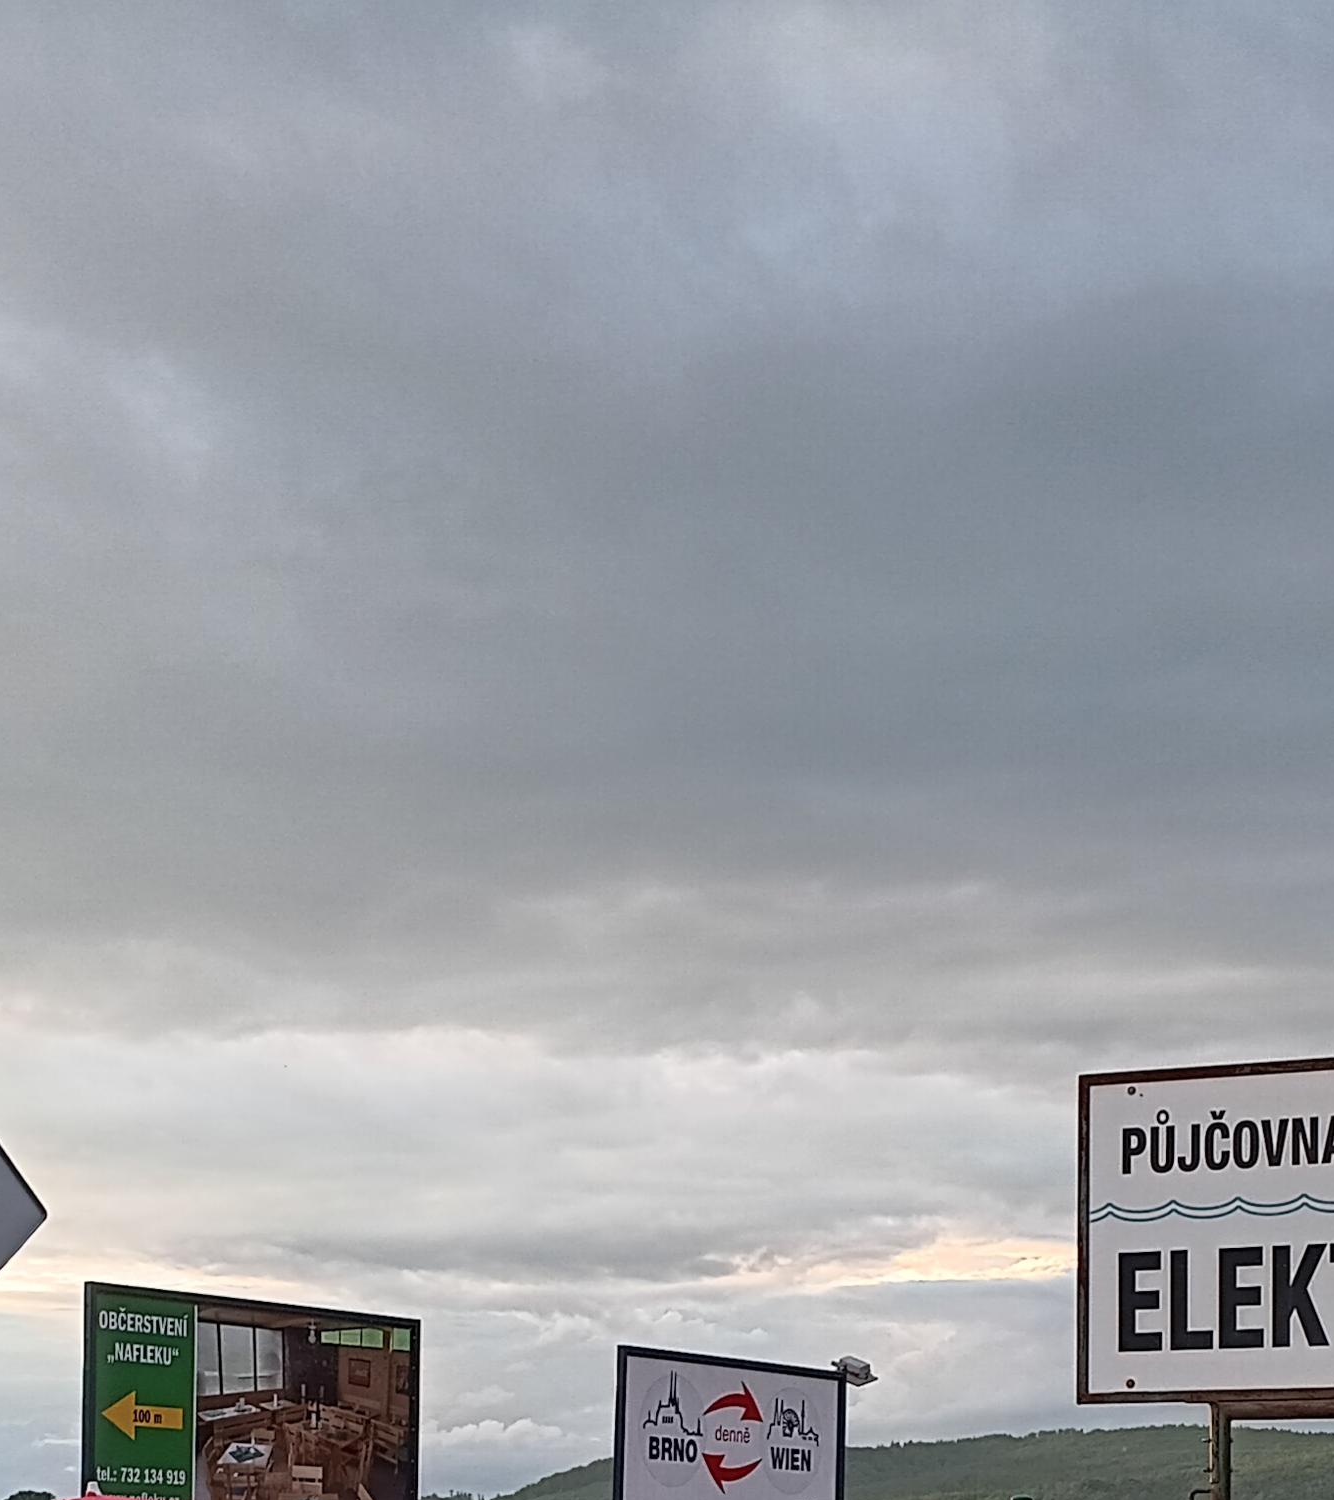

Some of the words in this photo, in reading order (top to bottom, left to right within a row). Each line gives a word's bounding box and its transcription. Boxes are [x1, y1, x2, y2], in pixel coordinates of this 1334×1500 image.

[98, 1307, 189, 1337] OBČERSTVENÍ
[107, 1343, 179, 1366] „NAFLEKU“
[132, 1409, 151, 1424] 100
[153, 1413, 163, 1424] m
[715, 1425, 750, 1443] denně
[648, 1436, 698, 1463] BRNO
[770, 1446, 811, 1471] WIEN
[96, 1466, 117, 1482] tel.:
[120, 1467, 141, 1483] 732
[144, 1468, 164, 1485] 134
[166, 1469, 186, 1486] 919
